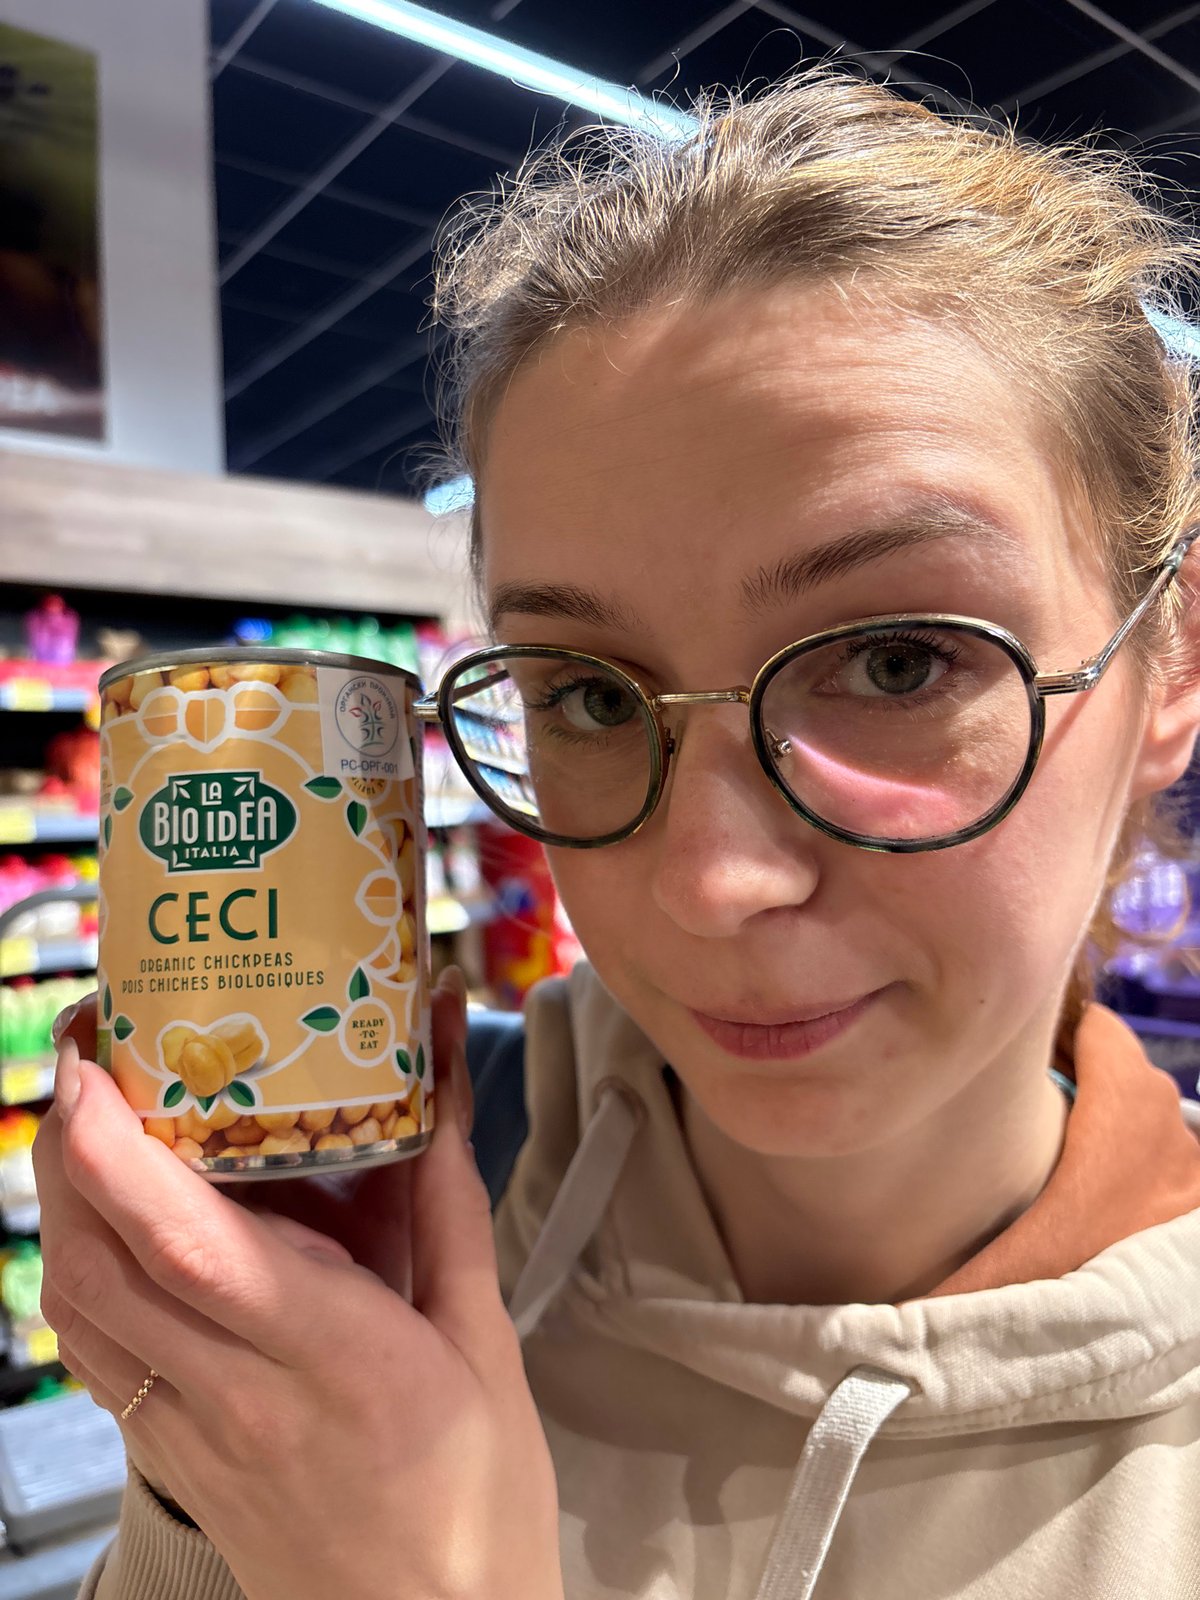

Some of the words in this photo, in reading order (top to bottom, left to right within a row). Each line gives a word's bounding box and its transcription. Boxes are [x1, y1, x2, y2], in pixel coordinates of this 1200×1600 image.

[201, 781, 223, 806] LA
[154, 802, 199, 847] BIO
[207, 796, 278, 842] IDEA
[185, 846, 240, 859] ITALIA
[148, 888, 278, 945] CECI
[139, 956, 196, 974] ORGANIC
[204, 952, 294, 970] CHICKPEAS
[121, 979, 144, 994] POIS
[149, 975, 209, 993] CHICHES
[217, 970, 325, 990] BIOLOGIQUES
[352, 1018, 385, 1029] READY
[359, 1040, 379, 1050] EAT
